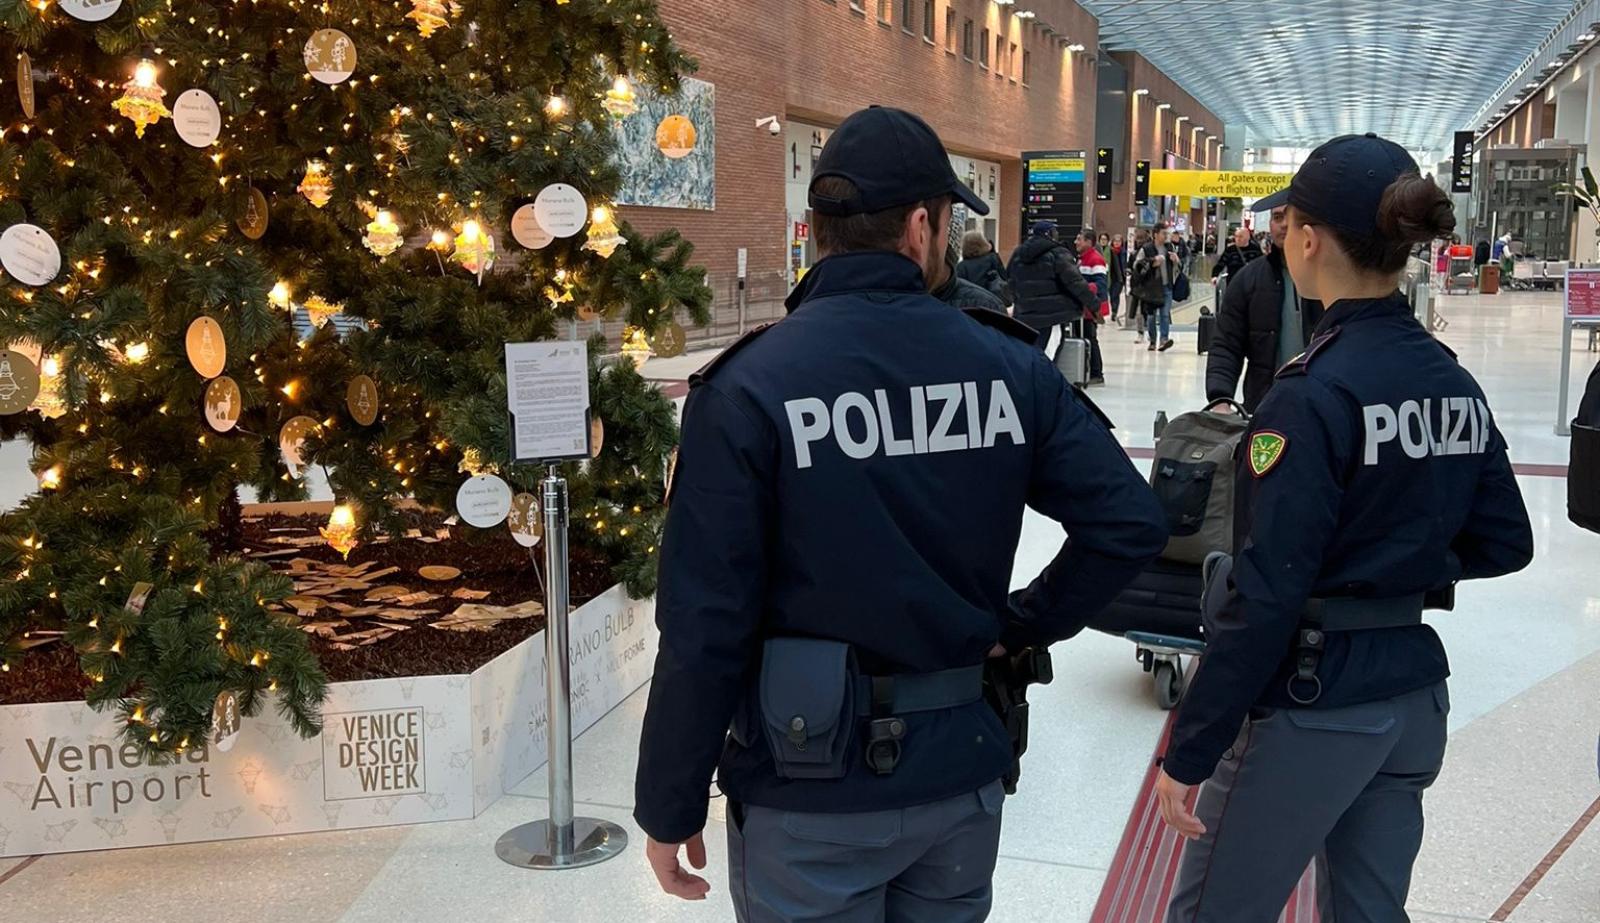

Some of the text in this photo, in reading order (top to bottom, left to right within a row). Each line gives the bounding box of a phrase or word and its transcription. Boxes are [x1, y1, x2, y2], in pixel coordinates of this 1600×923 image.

[1199, 184, 1284, 196] direct flights to US
[1218, 173, 1286, 185] All gates except
[784, 379, 1025, 468] POLIZIA
[605, 607, 634, 642] BULB
[343, 712, 418, 742] VENICE
[25, 737, 209, 774] Venea
[339, 738, 419, 768] DESIGN
[31, 767, 211, 814] Airport
[359, 763, 419, 792] WEEK
